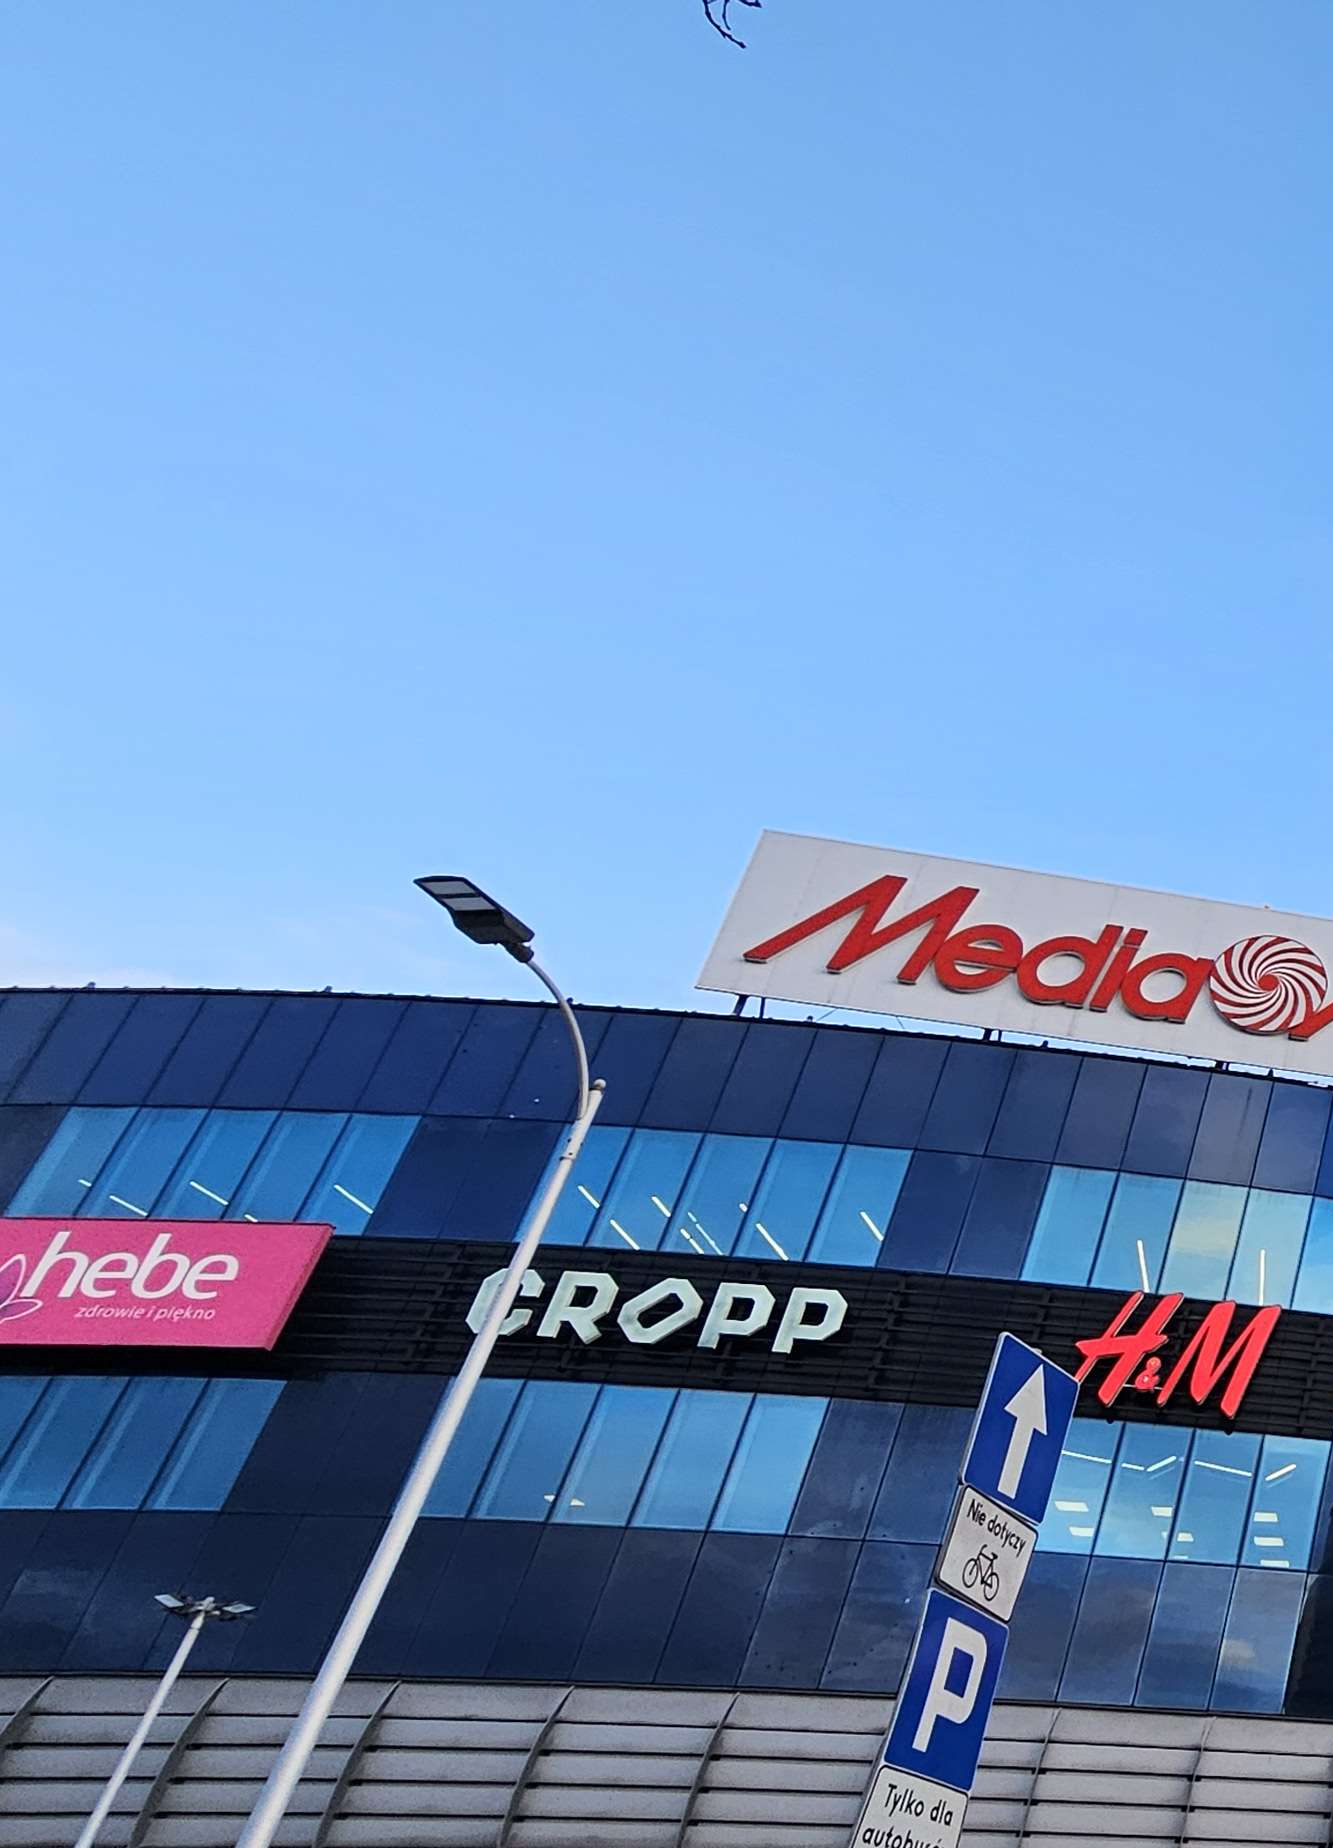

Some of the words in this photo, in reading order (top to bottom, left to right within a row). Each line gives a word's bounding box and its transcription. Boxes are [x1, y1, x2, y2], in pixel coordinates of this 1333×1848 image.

[742, 874, 1214, 1024] Media
[20, 1231, 239, 1300] hebe
[74, 1304, 145, 1320] zdrowie
[154, 1306, 216, 1323] piękno
[465, 1268, 848, 1353] CROPP
[1076, 1290, 1282, 1419] H&M
[967, 1497, 988, 1527] Nie
[988, 1517, 1026, 1557] dotyczy
[912, 1617, 988, 1752] P
[885, 1783, 924, 1817] Tylko
[930, 1799, 953, 1826] dla
